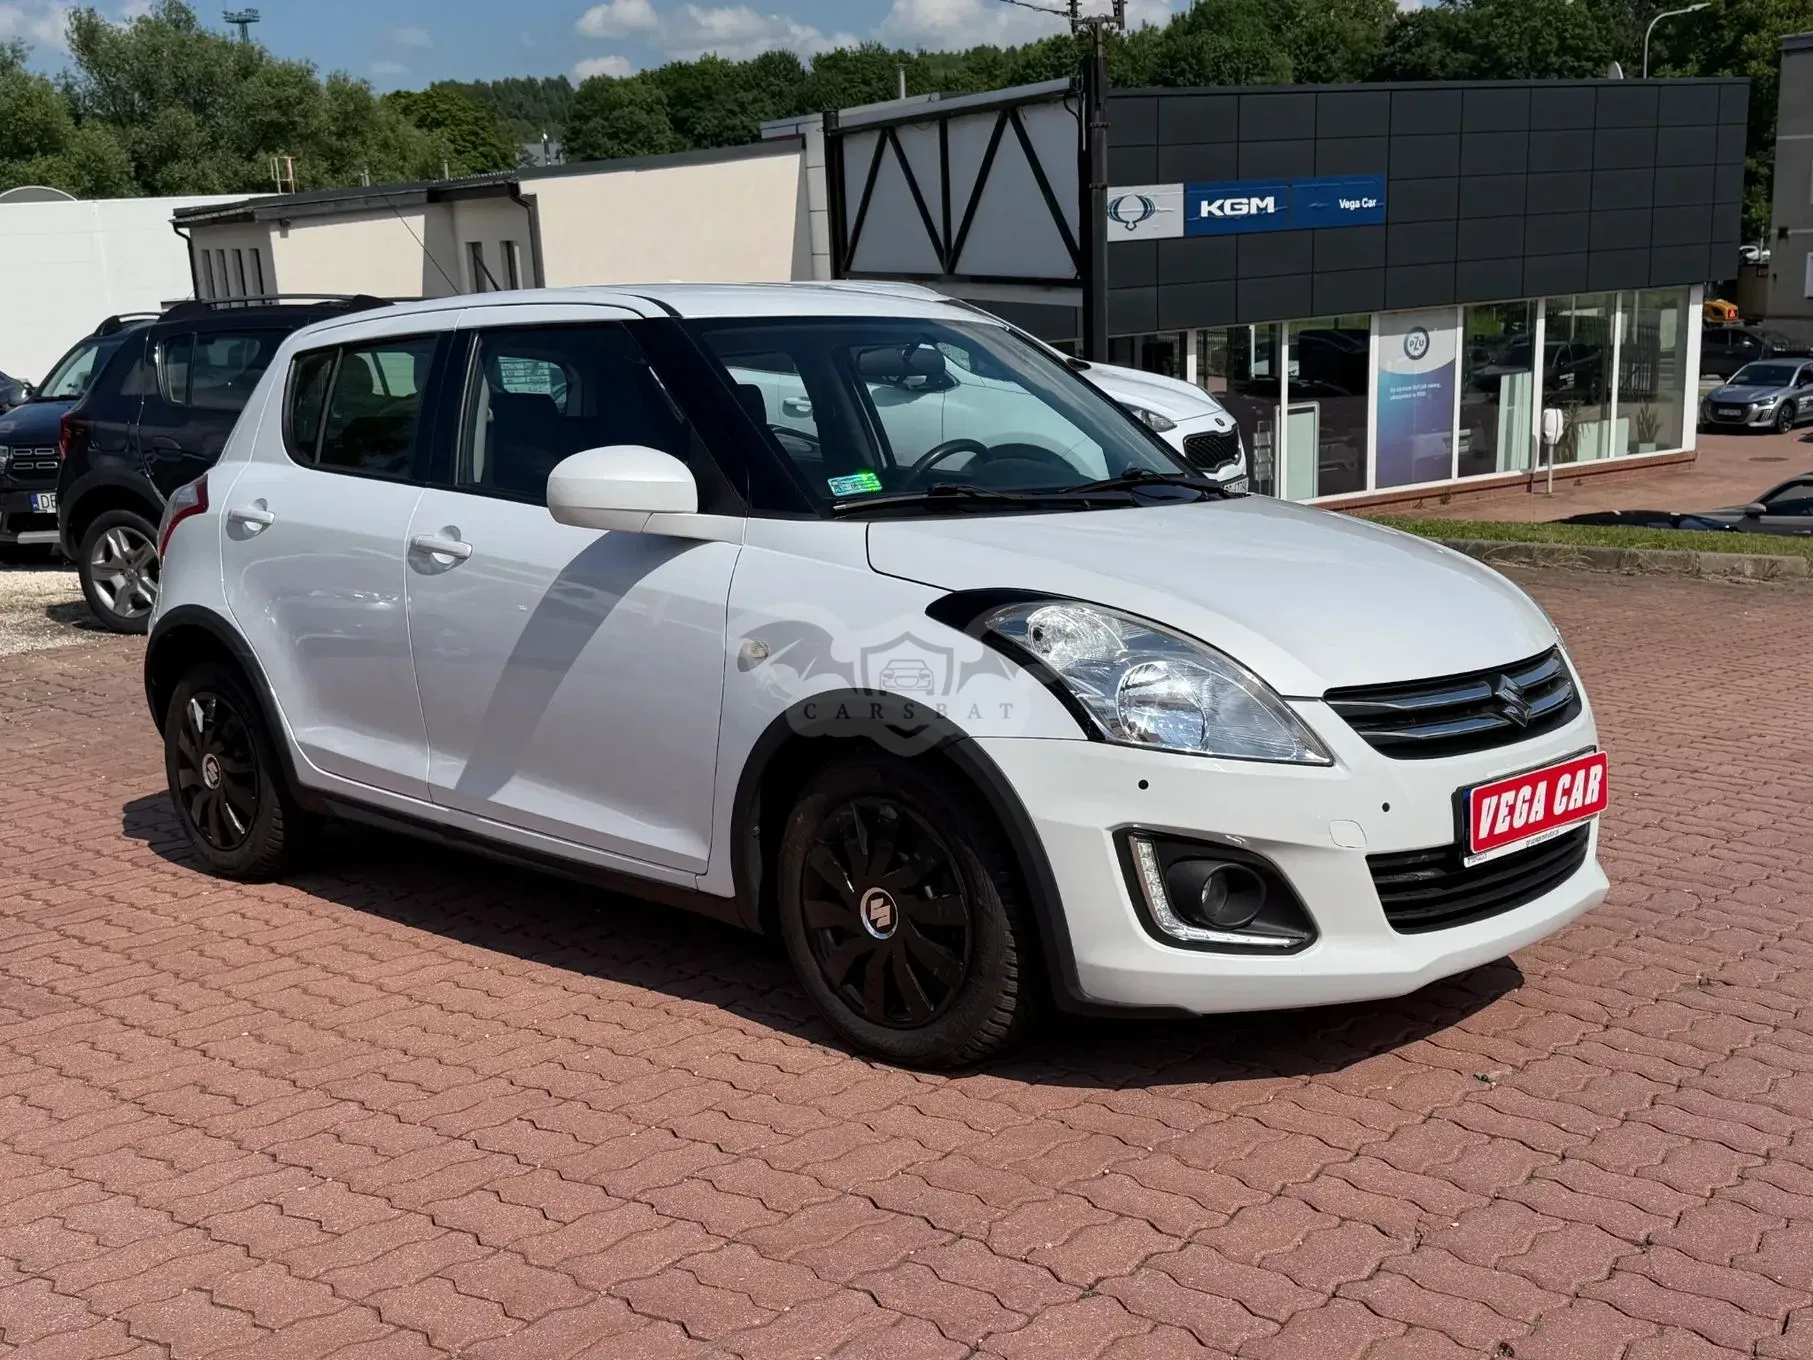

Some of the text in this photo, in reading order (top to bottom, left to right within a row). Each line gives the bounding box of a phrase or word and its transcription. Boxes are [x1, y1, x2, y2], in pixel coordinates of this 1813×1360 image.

[1200, 196, 1275, 217] KGM
[1339, 197, 1377, 211] Vega Car
[1409, 335, 1425, 351] PZU
[1478, 764, 1603, 840] VEGA CAR
